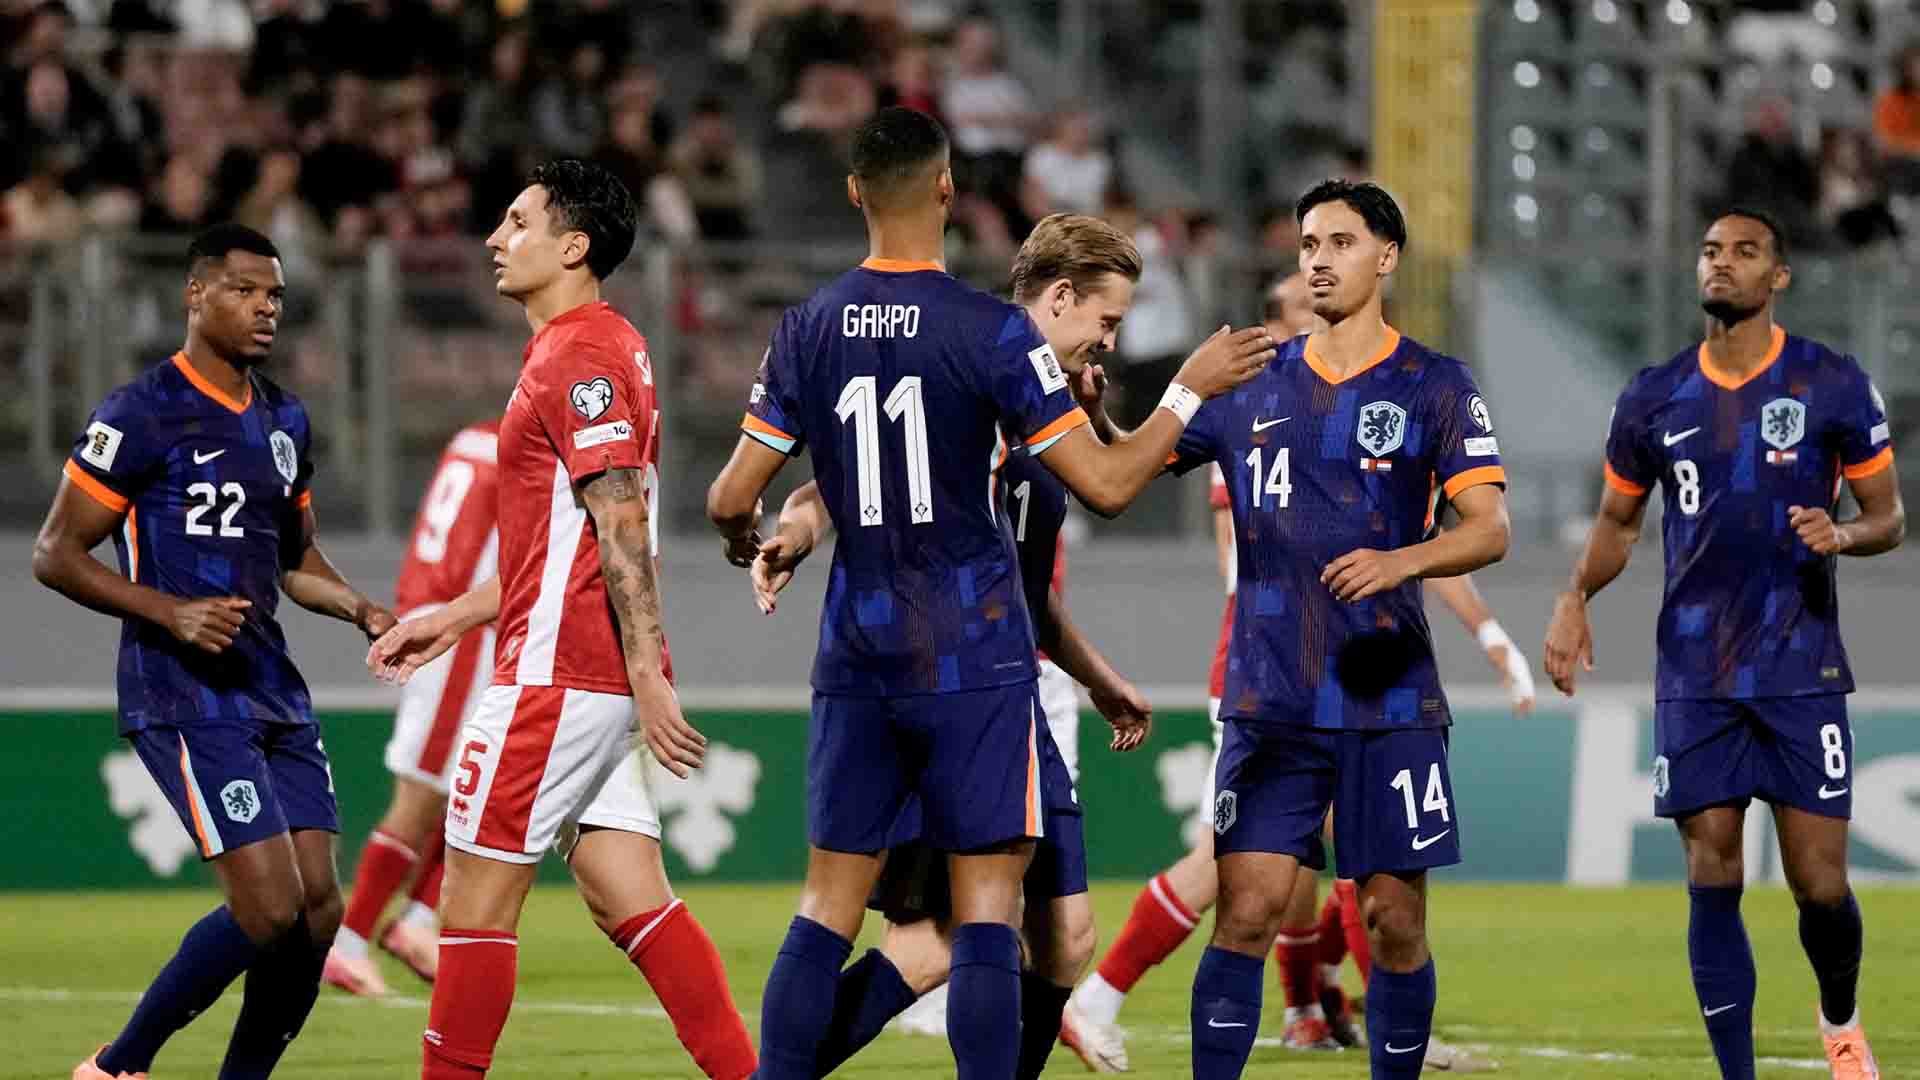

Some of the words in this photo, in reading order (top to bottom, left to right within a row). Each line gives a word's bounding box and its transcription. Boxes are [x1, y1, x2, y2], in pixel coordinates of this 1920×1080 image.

[842, 304, 921, 338] GAKPO
[834, 375, 934, 527] 11
[1246, 447, 1293, 508] 14
[186, 482, 246, 538] 22
[415, 460, 474, 564] 9
[1673, 459, 1700, 515] 8
[456, 741, 488, 796] 5
[1819, 723, 1847, 779] 8
[1390, 763, 1449, 828] 14
